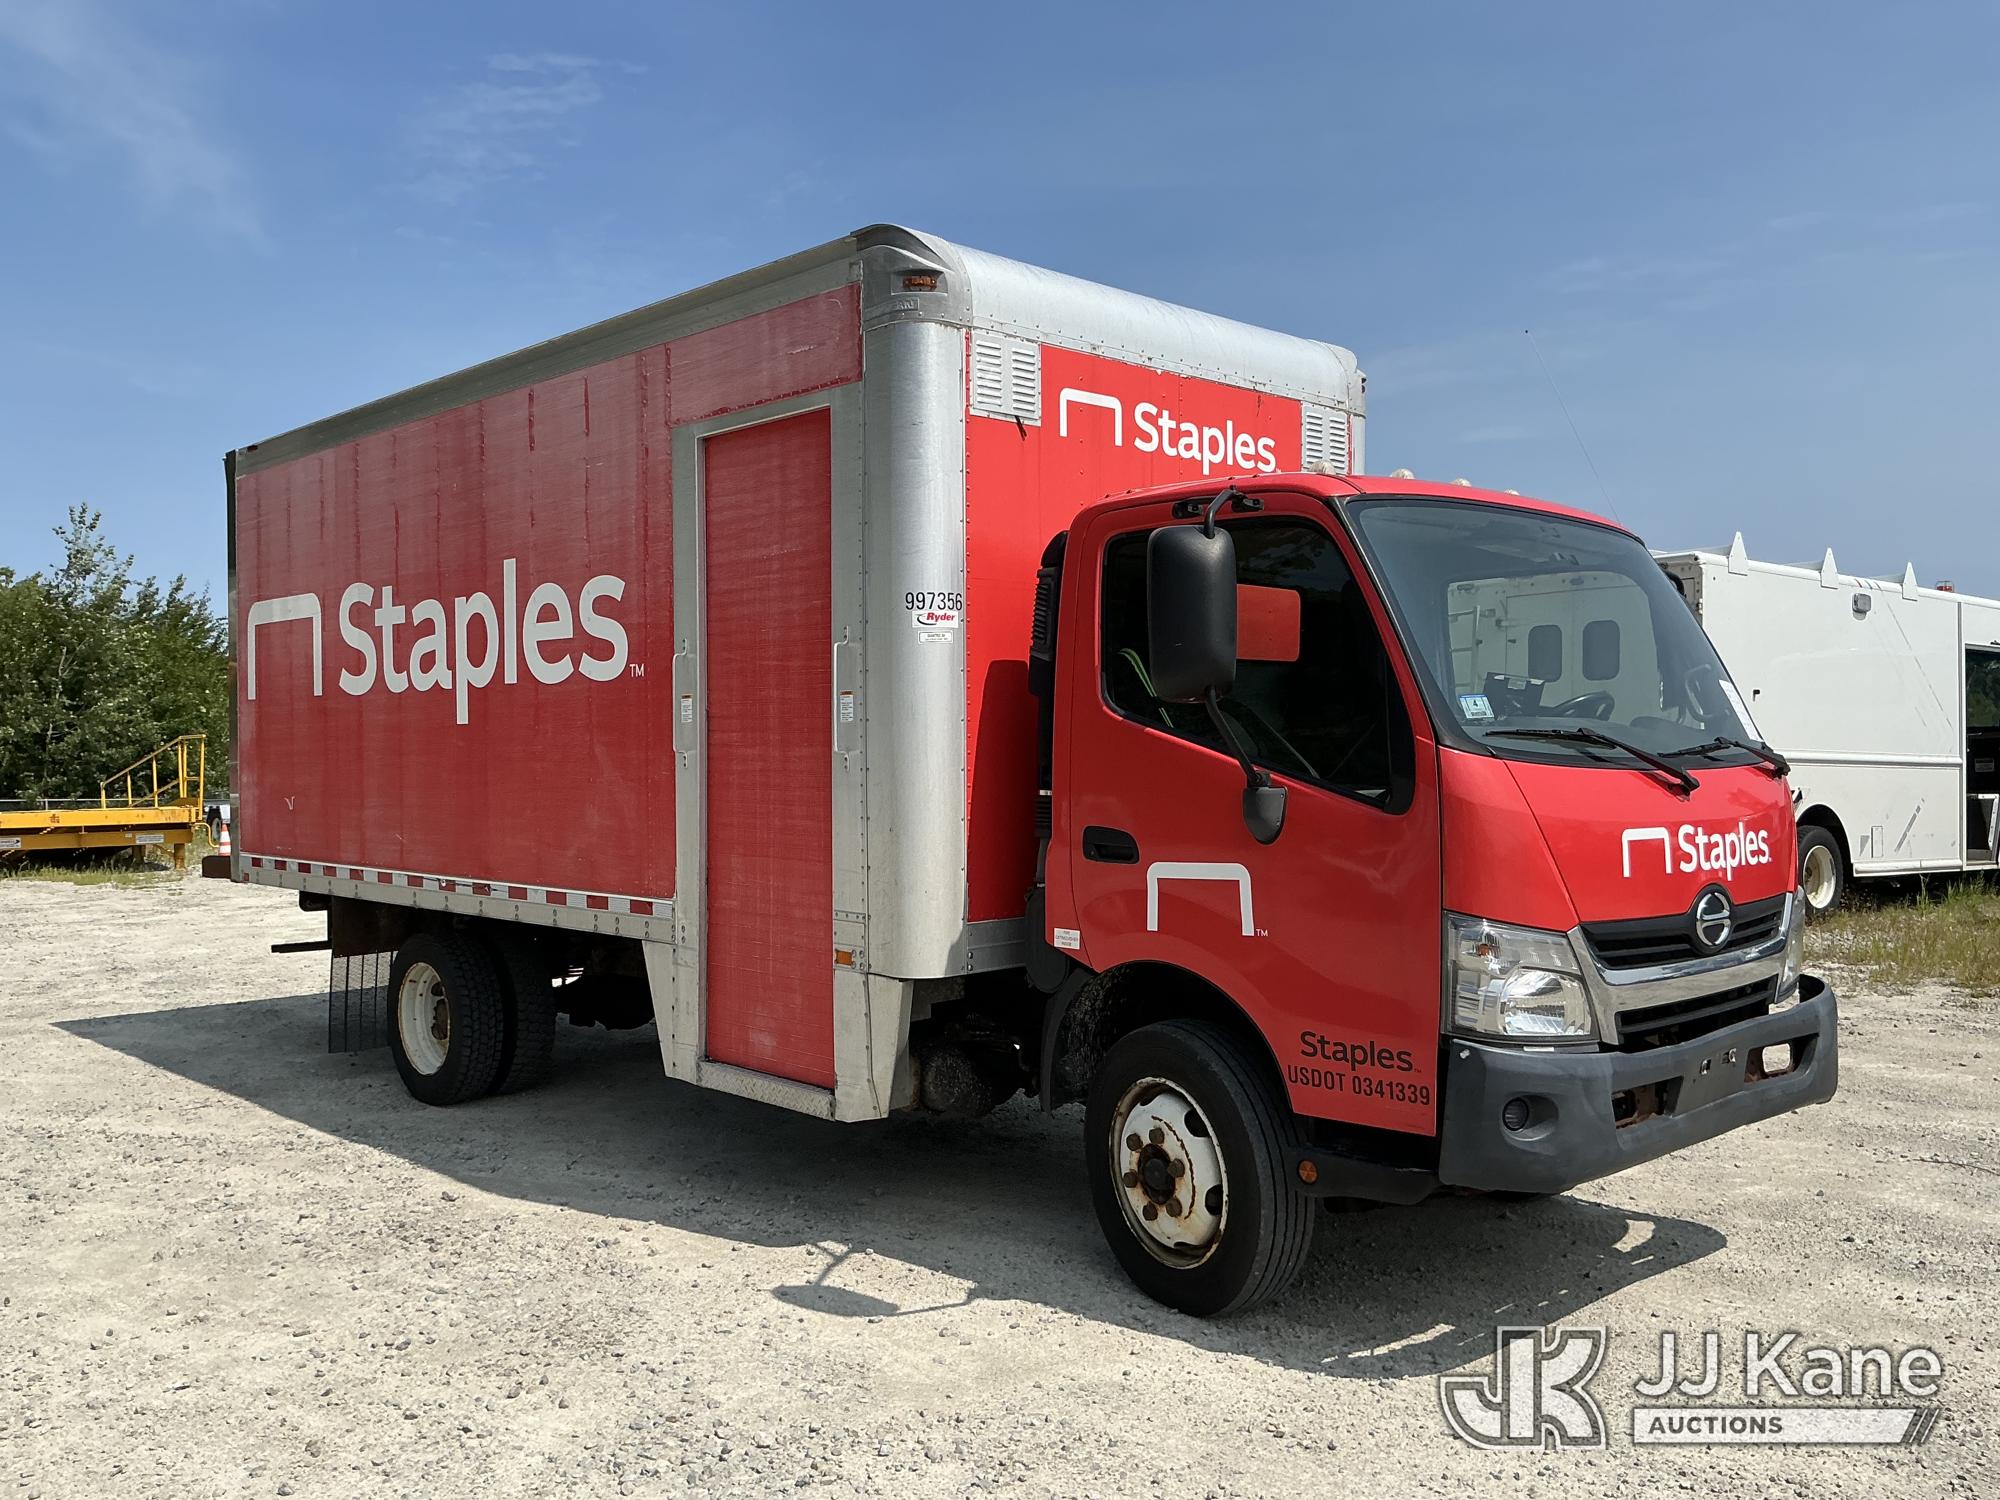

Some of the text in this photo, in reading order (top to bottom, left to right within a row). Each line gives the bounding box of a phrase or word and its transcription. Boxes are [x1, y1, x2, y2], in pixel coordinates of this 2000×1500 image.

[1134, 402, 1276, 475] Staples
[905, 592, 963, 611] 997356
[926, 612, 956, 623] Ryder
[339, 558, 629, 724] Staples
[1678, 821, 1770, 881] Staples
[1300, 1031, 1413, 1072] Staples
[1287, 1064, 1431, 1106] USDOT 0341339
